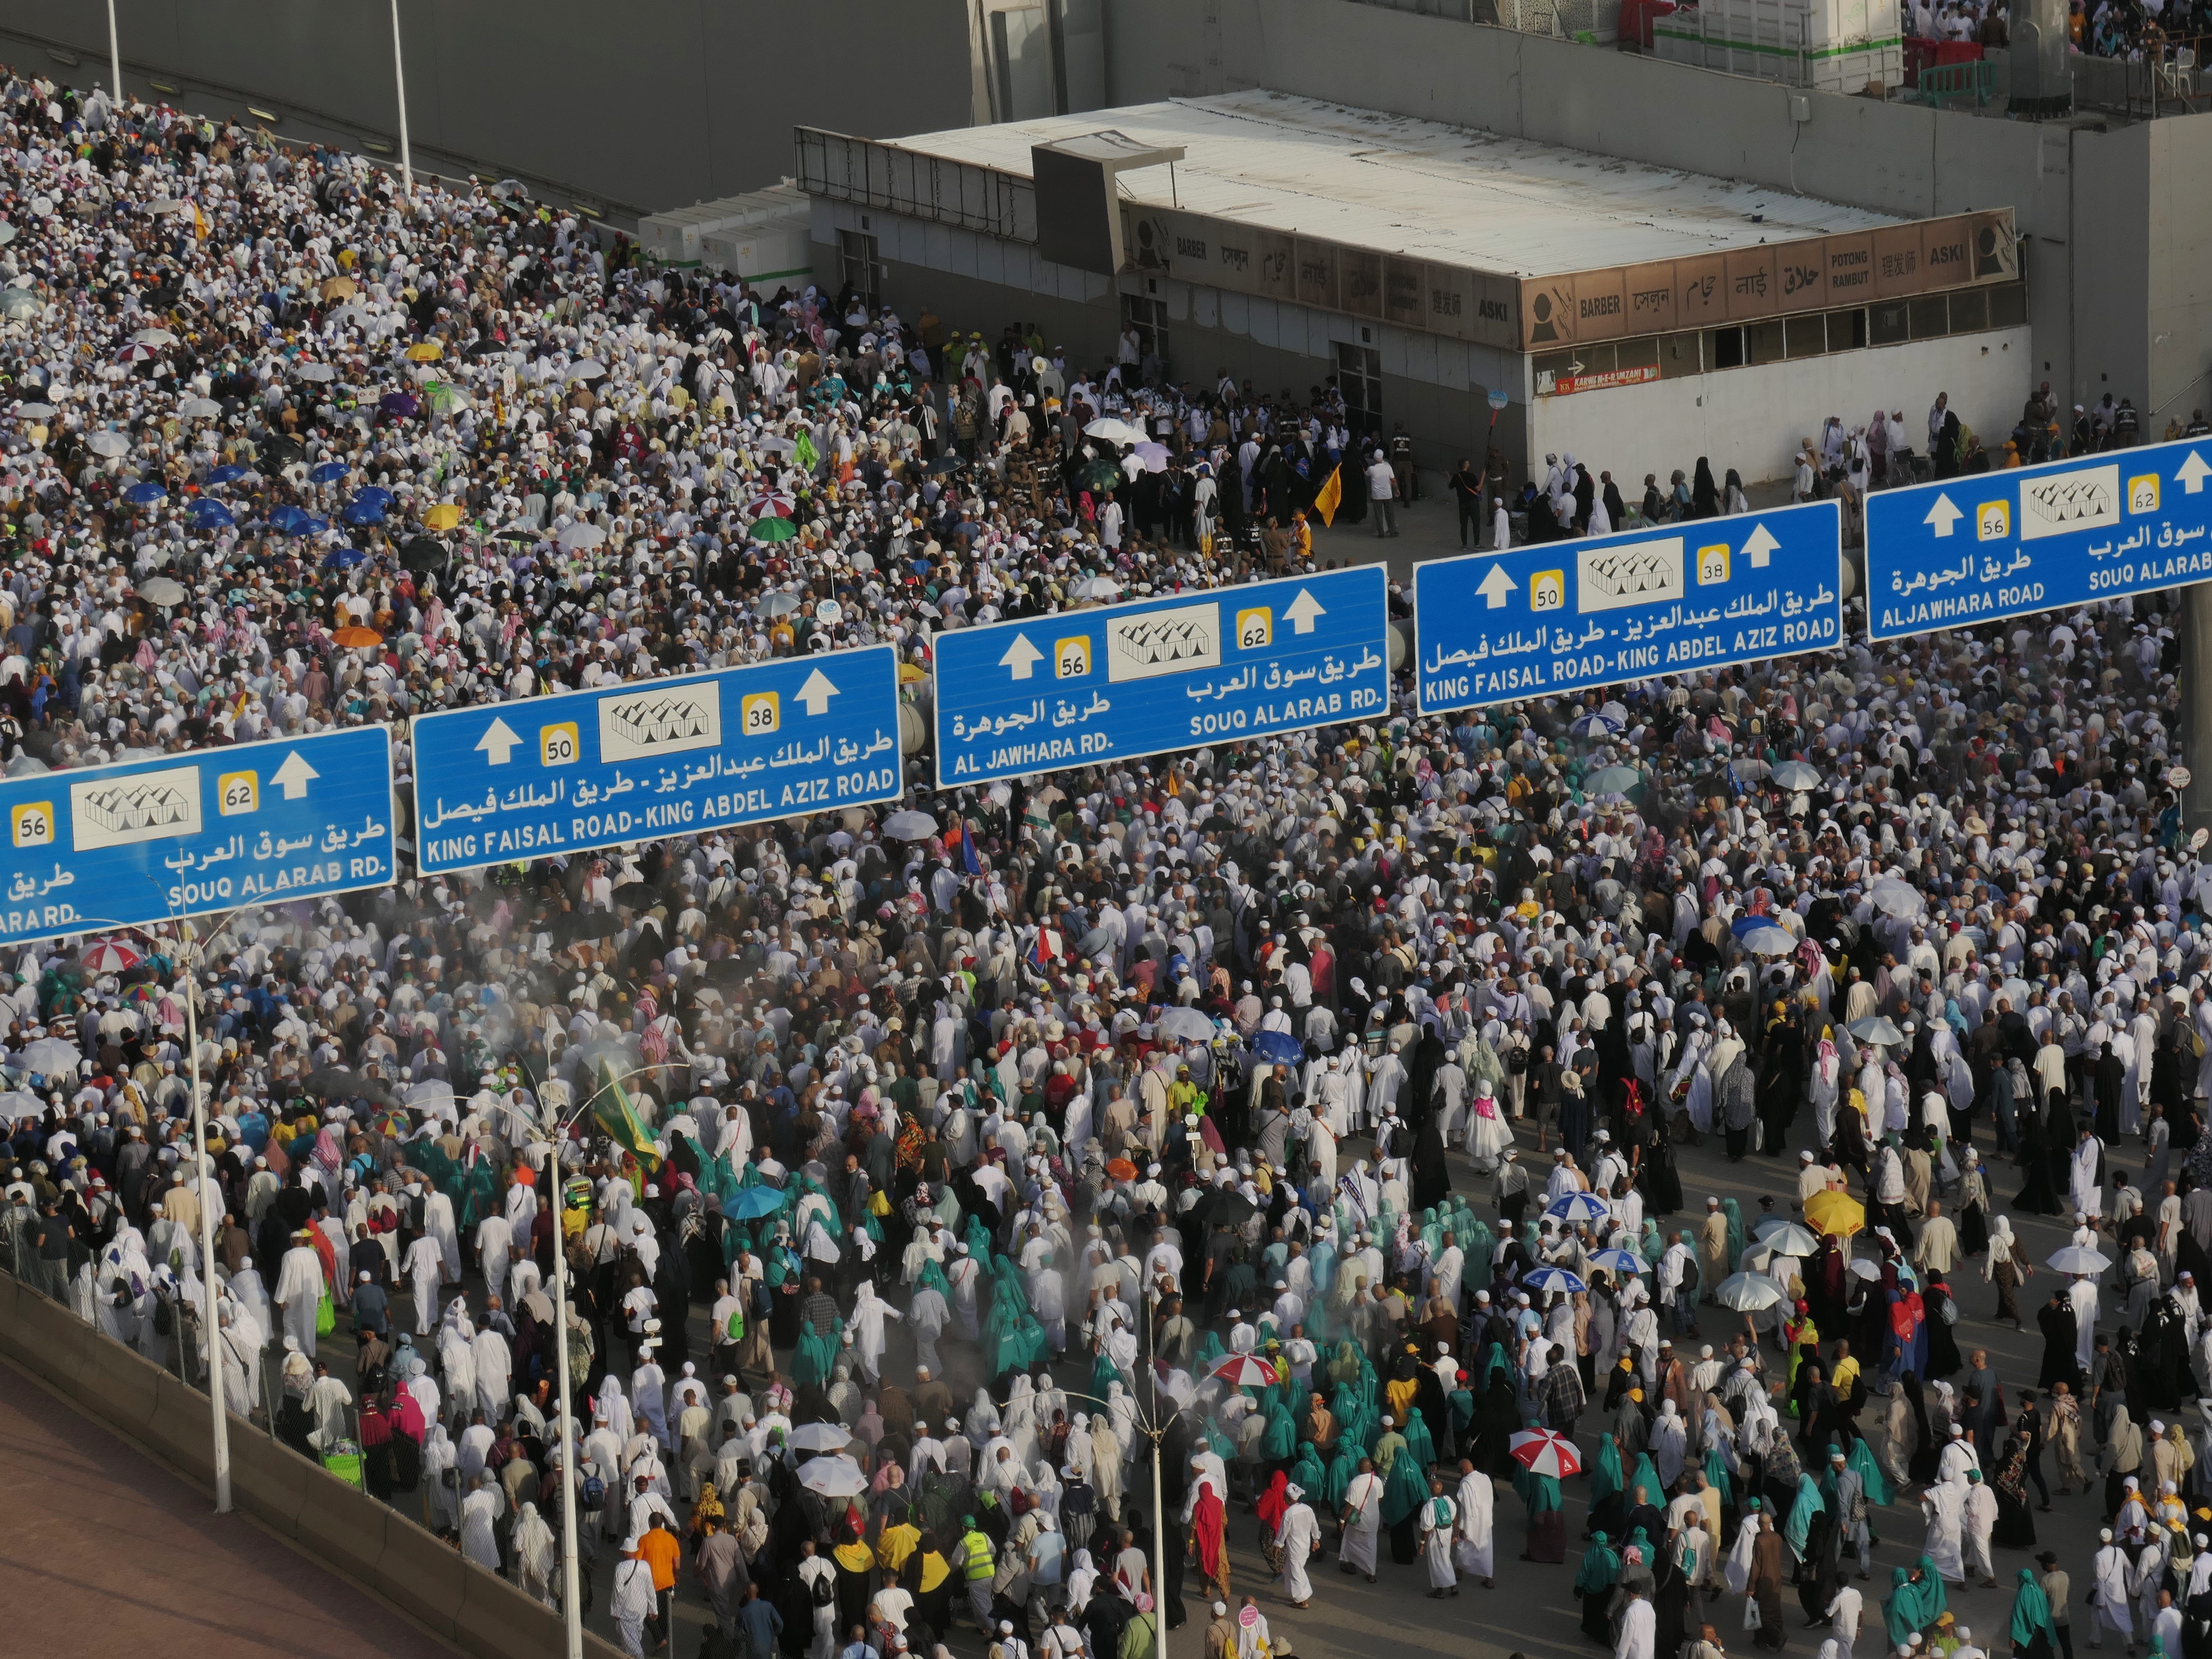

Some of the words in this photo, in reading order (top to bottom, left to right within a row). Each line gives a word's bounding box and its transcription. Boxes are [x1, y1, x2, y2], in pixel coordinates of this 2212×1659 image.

[1177, 237, 1207, 260] BARBER
[1832, 250, 1868, 269] POTONG
[1930, 243, 1964, 266] ASKI
[1833, 270, 1869, 288] RAMBUT
[1882, 250, 1916, 279] 理发师
[1735, 267, 1767, 298] नाई
[1784, 265, 1819, 296] حلاق
[1479, 299, 1508, 322] ASKI
[1580, 295, 1620, 319] BARBER
[1632, 288, 1670, 313] সেলুন
[2135, 493, 2154, 508] 62
[1983, 520, 2003, 535] 56
[2158, 522, 2204, 548] سوق
[2089, 526, 2150, 560] العرب
[1704, 565, 1722, 579] 38
[1892, 554, 1973, 596] الجوهرة
[1980, 548, 2031, 582] طريق
[2090, 565, 2133, 590] SOUQ
[1538, 590, 1557, 607] 50
[1725, 589, 1777, 618] الملك
[1781, 583, 1834, 617] طريق
[1999, 583, 2044, 607] ROAD
[1243, 628, 1265, 647] 62
[1492, 625, 1546, 656] الملك
[1551, 620, 1605, 654] طريق
[1062, 656, 1083, 676] 56
[1319, 646, 1381, 684] طريق
[1426, 634, 1488, 673] فيصل
[1426, 676, 1469, 702] KING
[1476, 665, 1545, 694] FAISAL
[1667, 636, 1726, 662] ABDEL
[1734, 626, 1777, 651] AZIZ
[1784, 618, 1834, 643] ROAD
[1187, 666, 1256, 702] العرب
[1264, 662, 1316, 689] سوق
[749, 708, 772, 727] 38
[954, 699, 1045, 742] الجوهرة
[1052, 691, 1110, 727] طريق
[1190, 710, 1246, 735] SOUQ
[1351, 688, 1382, 709] RD.
[548, 740, 571, 759] 50
[769, 735, 829, 768] الملك
[834, 728, 893, 765] طريق
[955, 754, 980, 774] AL
[986, 738, 1075, 769] JAWHARA
[1081, 733, 1113, 754] RD.
[226, 787, 250, 806] 62
[500, 778, 564, 810] الملك
[573, 770, 634, 807] طريق
[424, 787, 497, 828] فيصل
[428, 835, 476, 863] KING
[485, 823, 565, 854] FAISAL
[702, 789, 772, 819] ABDEL
[781, 779, 829, 806] AZIZ
[837, 769, 893, 796] ROAD
[21, 817, 45, 837] 56
[321, 815, 385, 852] طريق
[165, 835, 243, 873] العرب
[253, 831, 312, 860] سوق
[8, 863, 74, 901] طريق
[169, 877, 232, 907] SOUQ
[351, 856, 386, 878] RD.
[44, 904, 81, 928] RD.
[1810, 1218, 1824, 1229] DHL
[1848, 1222, 1860, 1232] DHL
